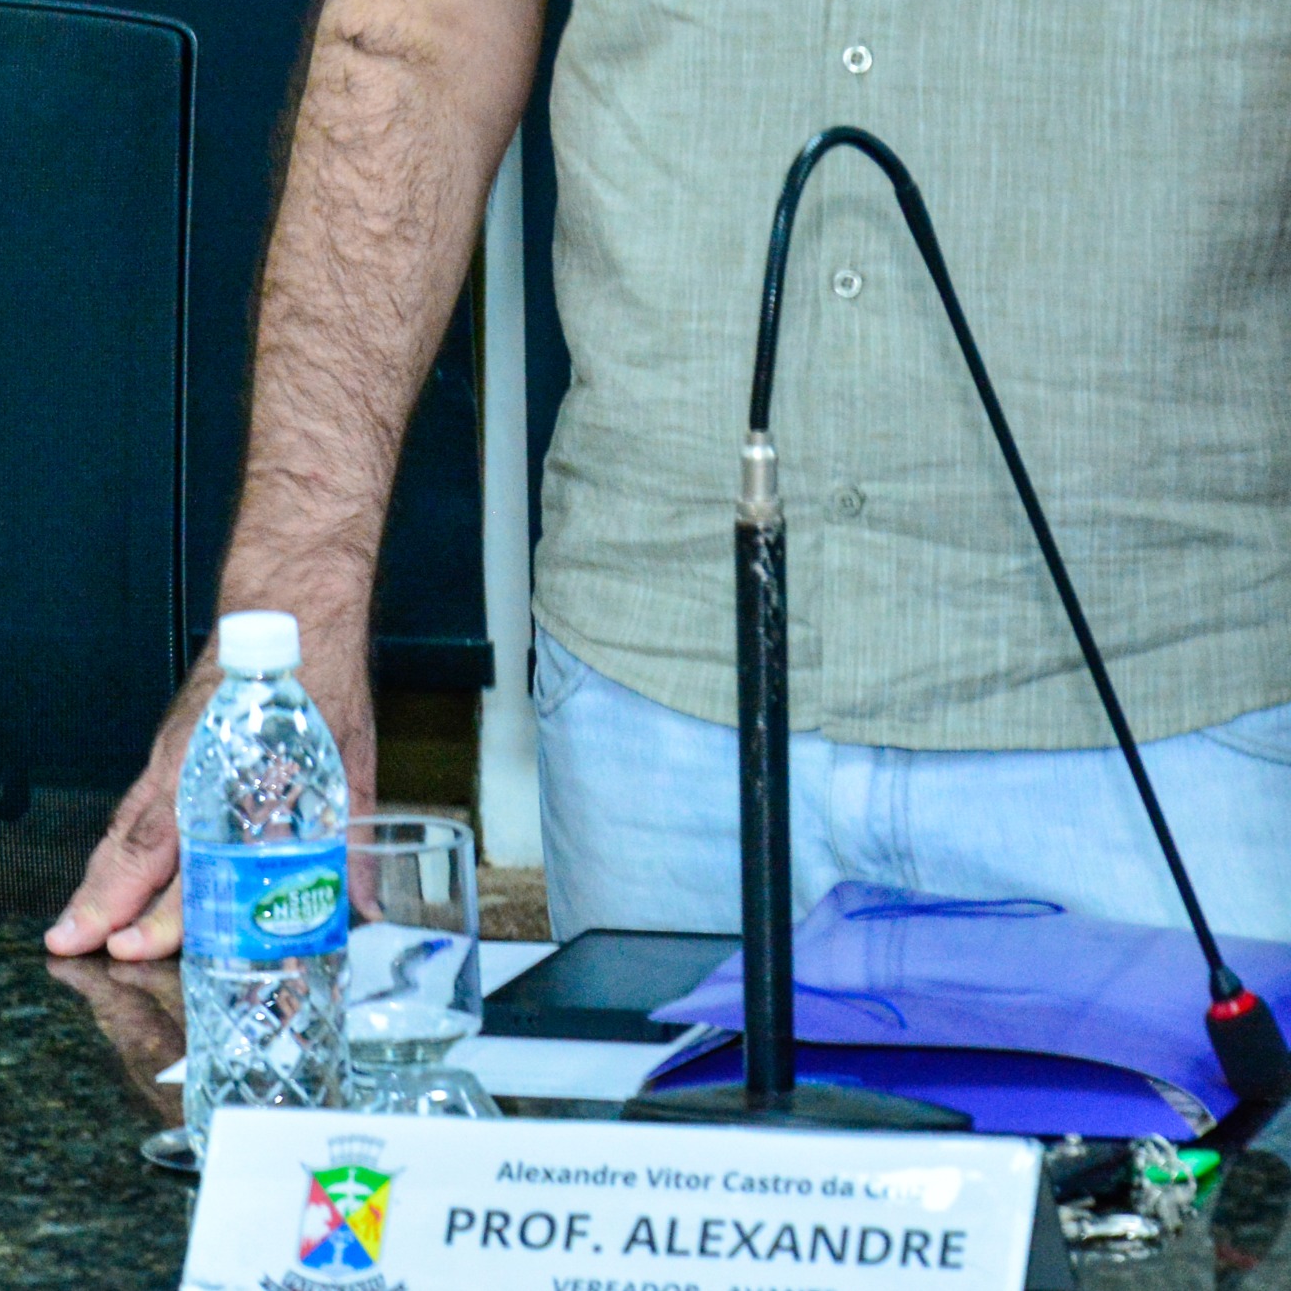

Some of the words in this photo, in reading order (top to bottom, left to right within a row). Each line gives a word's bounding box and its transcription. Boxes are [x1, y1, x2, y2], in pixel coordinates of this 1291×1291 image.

[496, 1161, 637, 1187] Alexandre
[646, 1167, 712, 1190] Vitor
[722, 1171, 812, 1196] Castro
[822, 1176, 854, 1197] da
[444, 1206, 602, 1254] PROF.
[623, 1215, 967, 1270] ALEXANDRE
